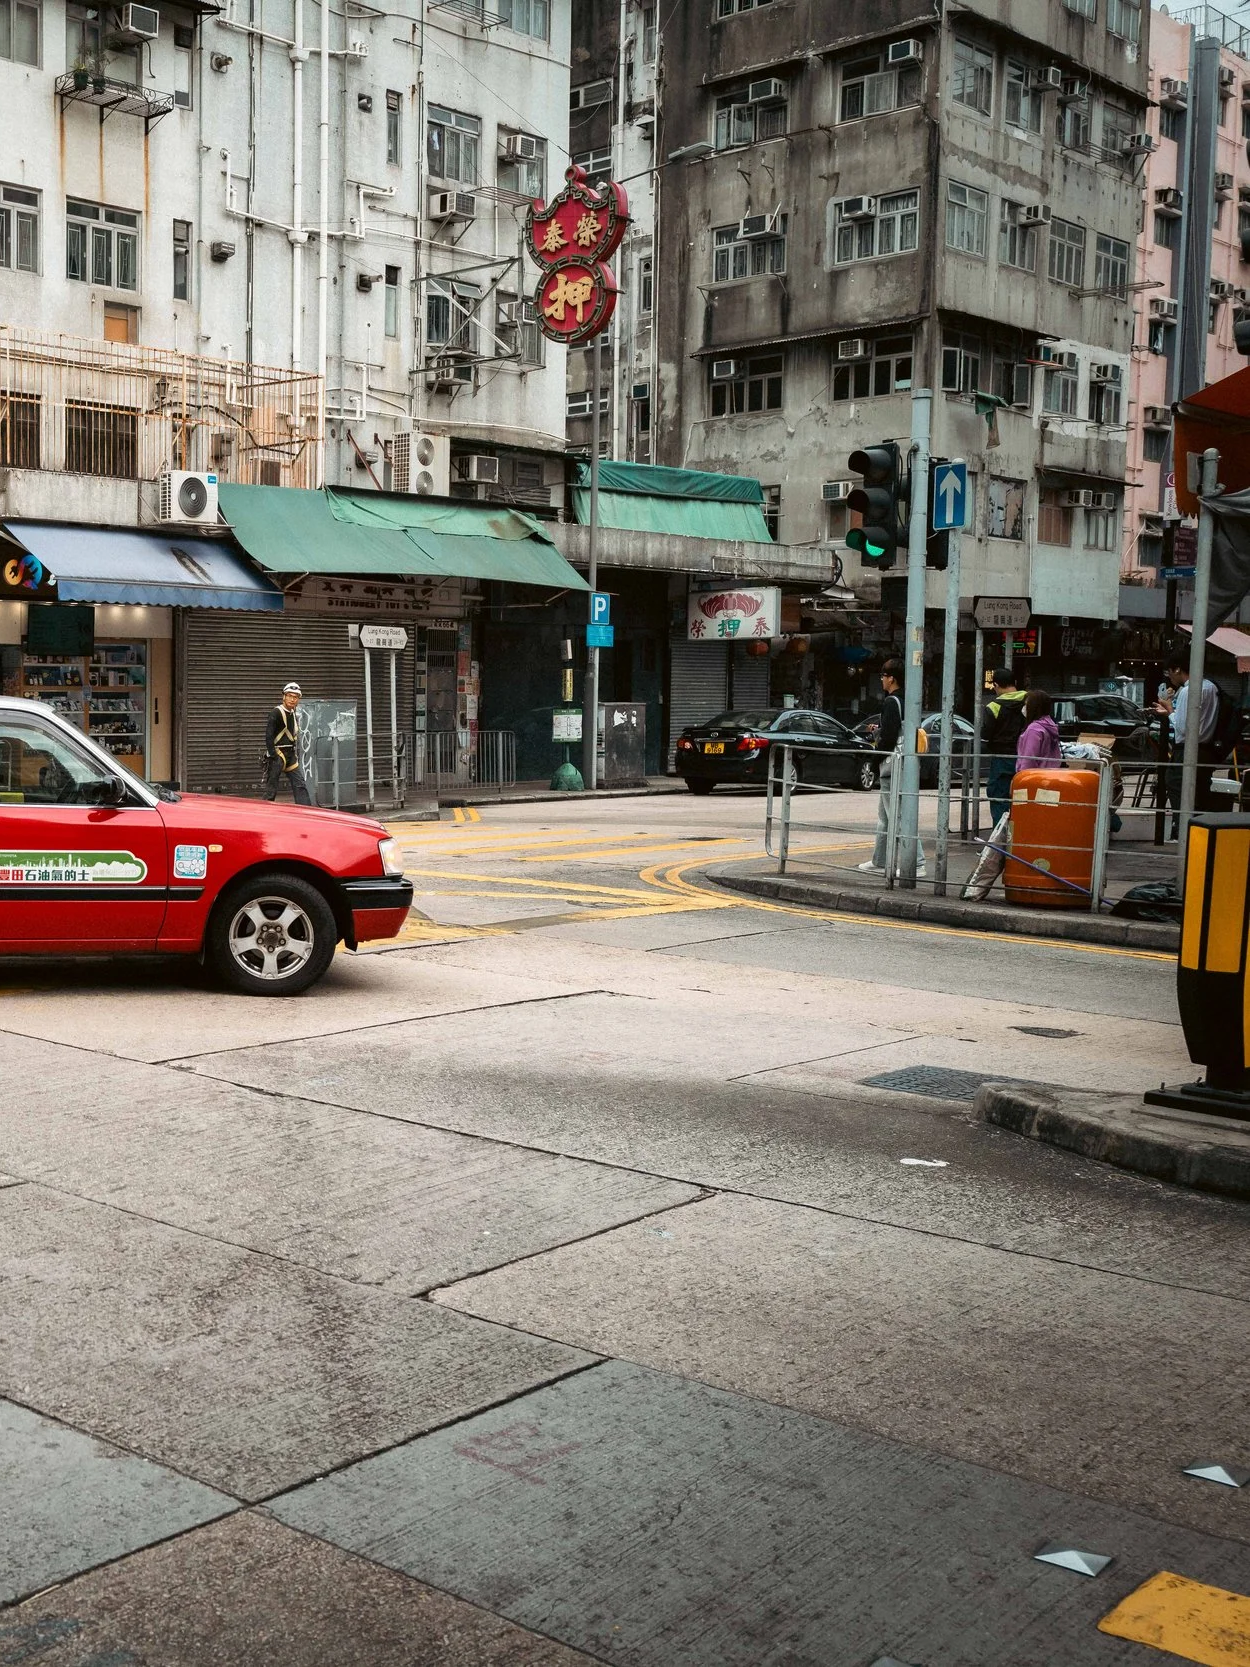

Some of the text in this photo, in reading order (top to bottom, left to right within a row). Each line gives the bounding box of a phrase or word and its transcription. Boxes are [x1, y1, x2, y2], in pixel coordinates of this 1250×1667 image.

[544, 273, 595, 323] 押
[594, 596, 607, 621] P
[367, 627, 378, 636] Lung
[379, 628, 390, 637] Kong
[717, 619, 742, 638] 押
[752, 617, 771, 637] 泰
